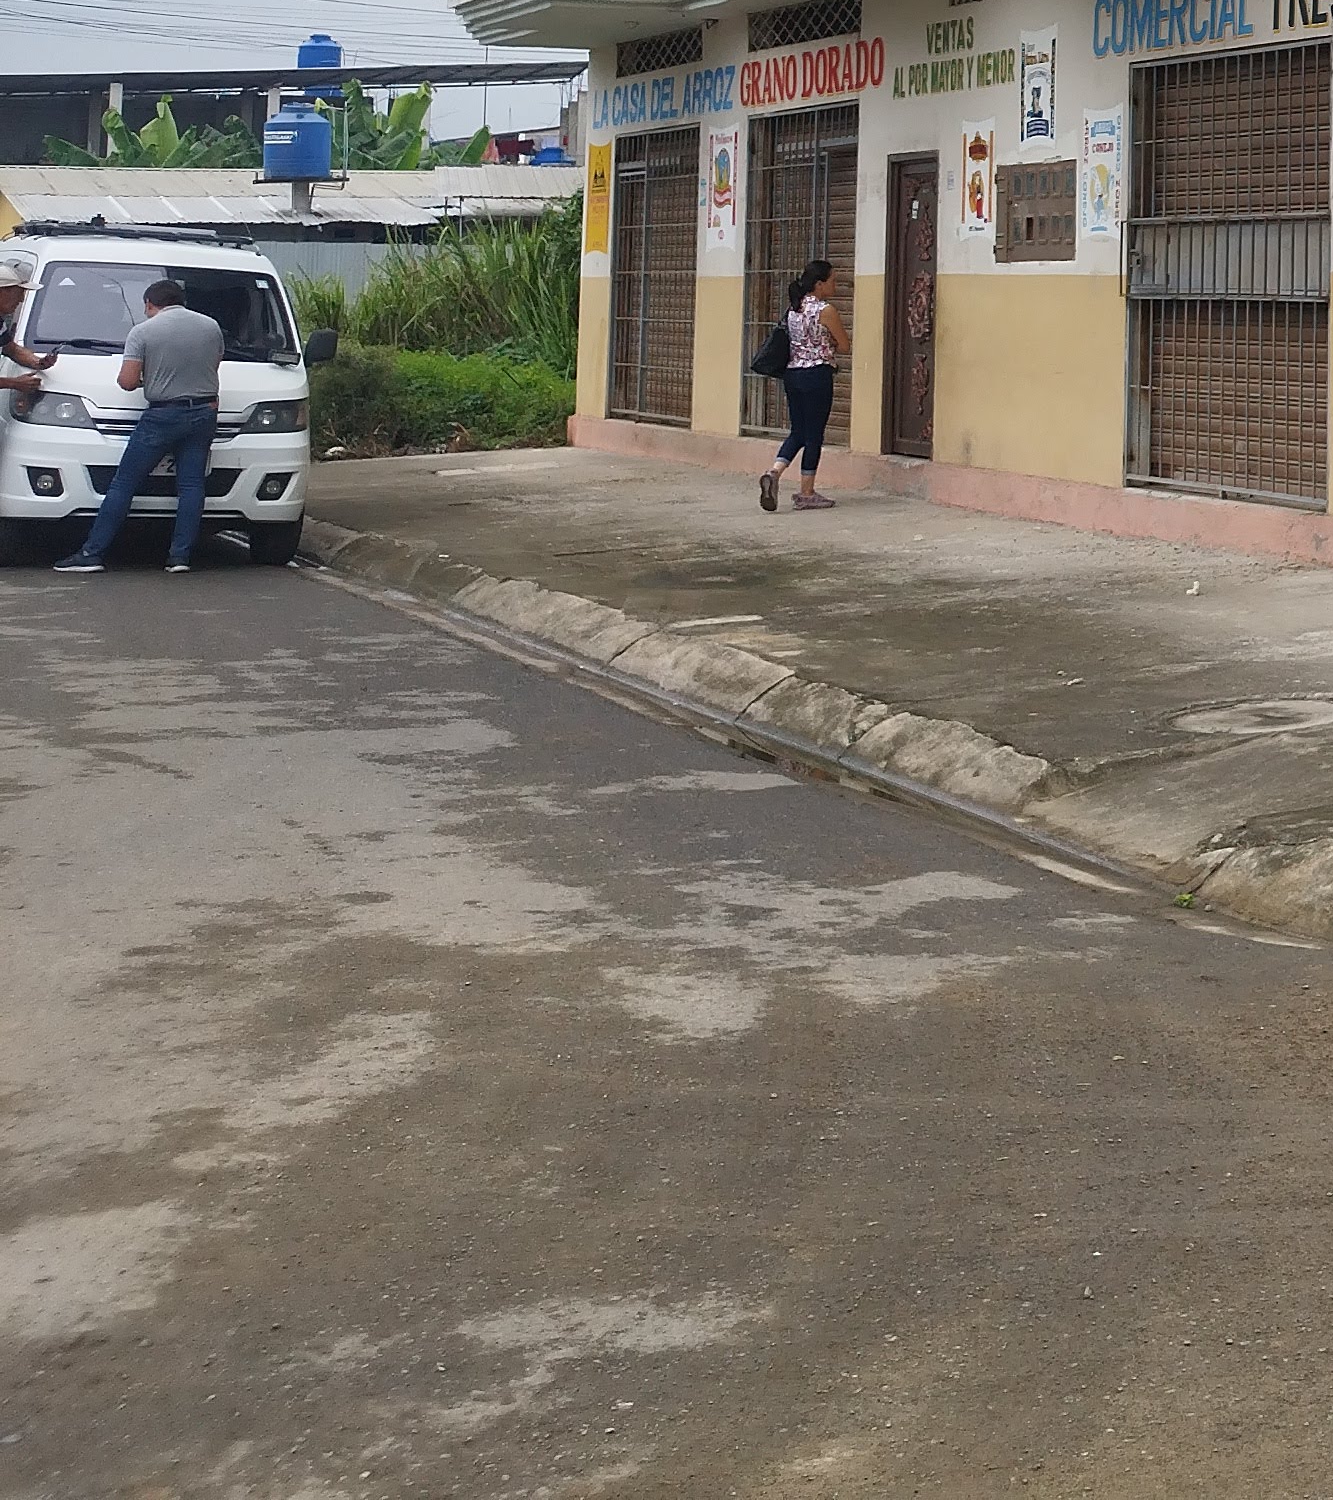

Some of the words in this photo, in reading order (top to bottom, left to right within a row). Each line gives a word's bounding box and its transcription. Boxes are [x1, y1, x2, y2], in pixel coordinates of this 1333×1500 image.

[926, 15, 974, 56] VENTAS
[592, 89, 609, 130] LA
[612, 81, 647, 126] CASA
[650, 76, 679, 121] DEL
[682, 65, 736, 118] ARROZ
[740, 54, 798, 107] GRANO
[801, 36, 885, 99] DORADO
[892, 66, 906, 100] AL
[908, 62, 928, 97] POR
[930, 58, 965, 95] MAYOR
[966, 55, 975, 91] Y
[976, 48, 1016, 89] MENOR
